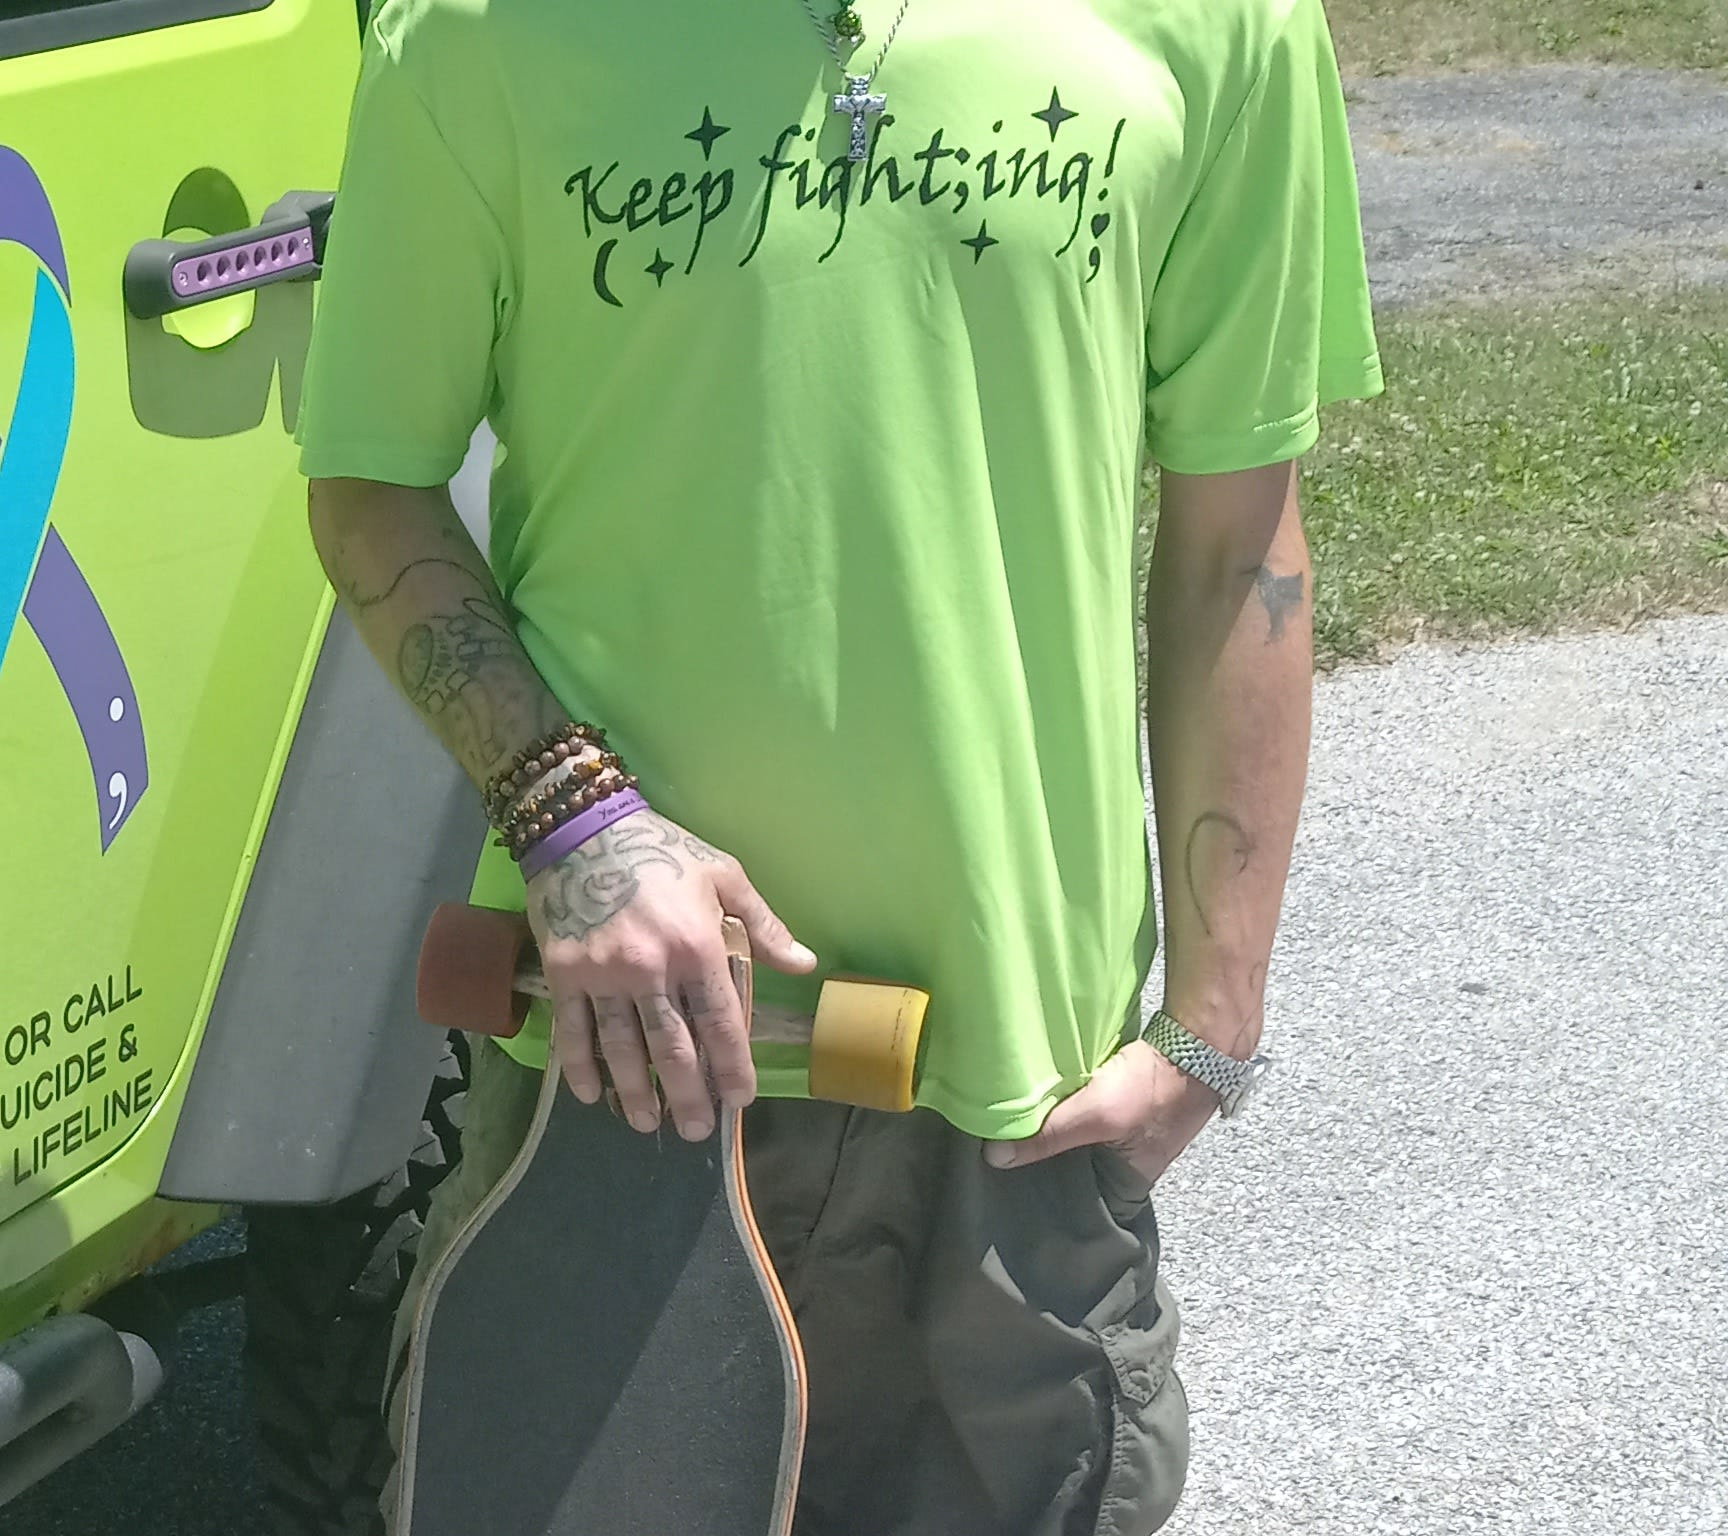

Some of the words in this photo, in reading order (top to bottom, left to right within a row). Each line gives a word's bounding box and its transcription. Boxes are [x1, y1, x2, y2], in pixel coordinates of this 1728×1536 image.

[565, 162, 735, 274] Keep
[5, 1013, 50, 1065] OR
[64, 965, 142, 1033] CALL
[119, 1024, 138, 1062] &
[14, 1069, 153, 1186] LIFELINE
